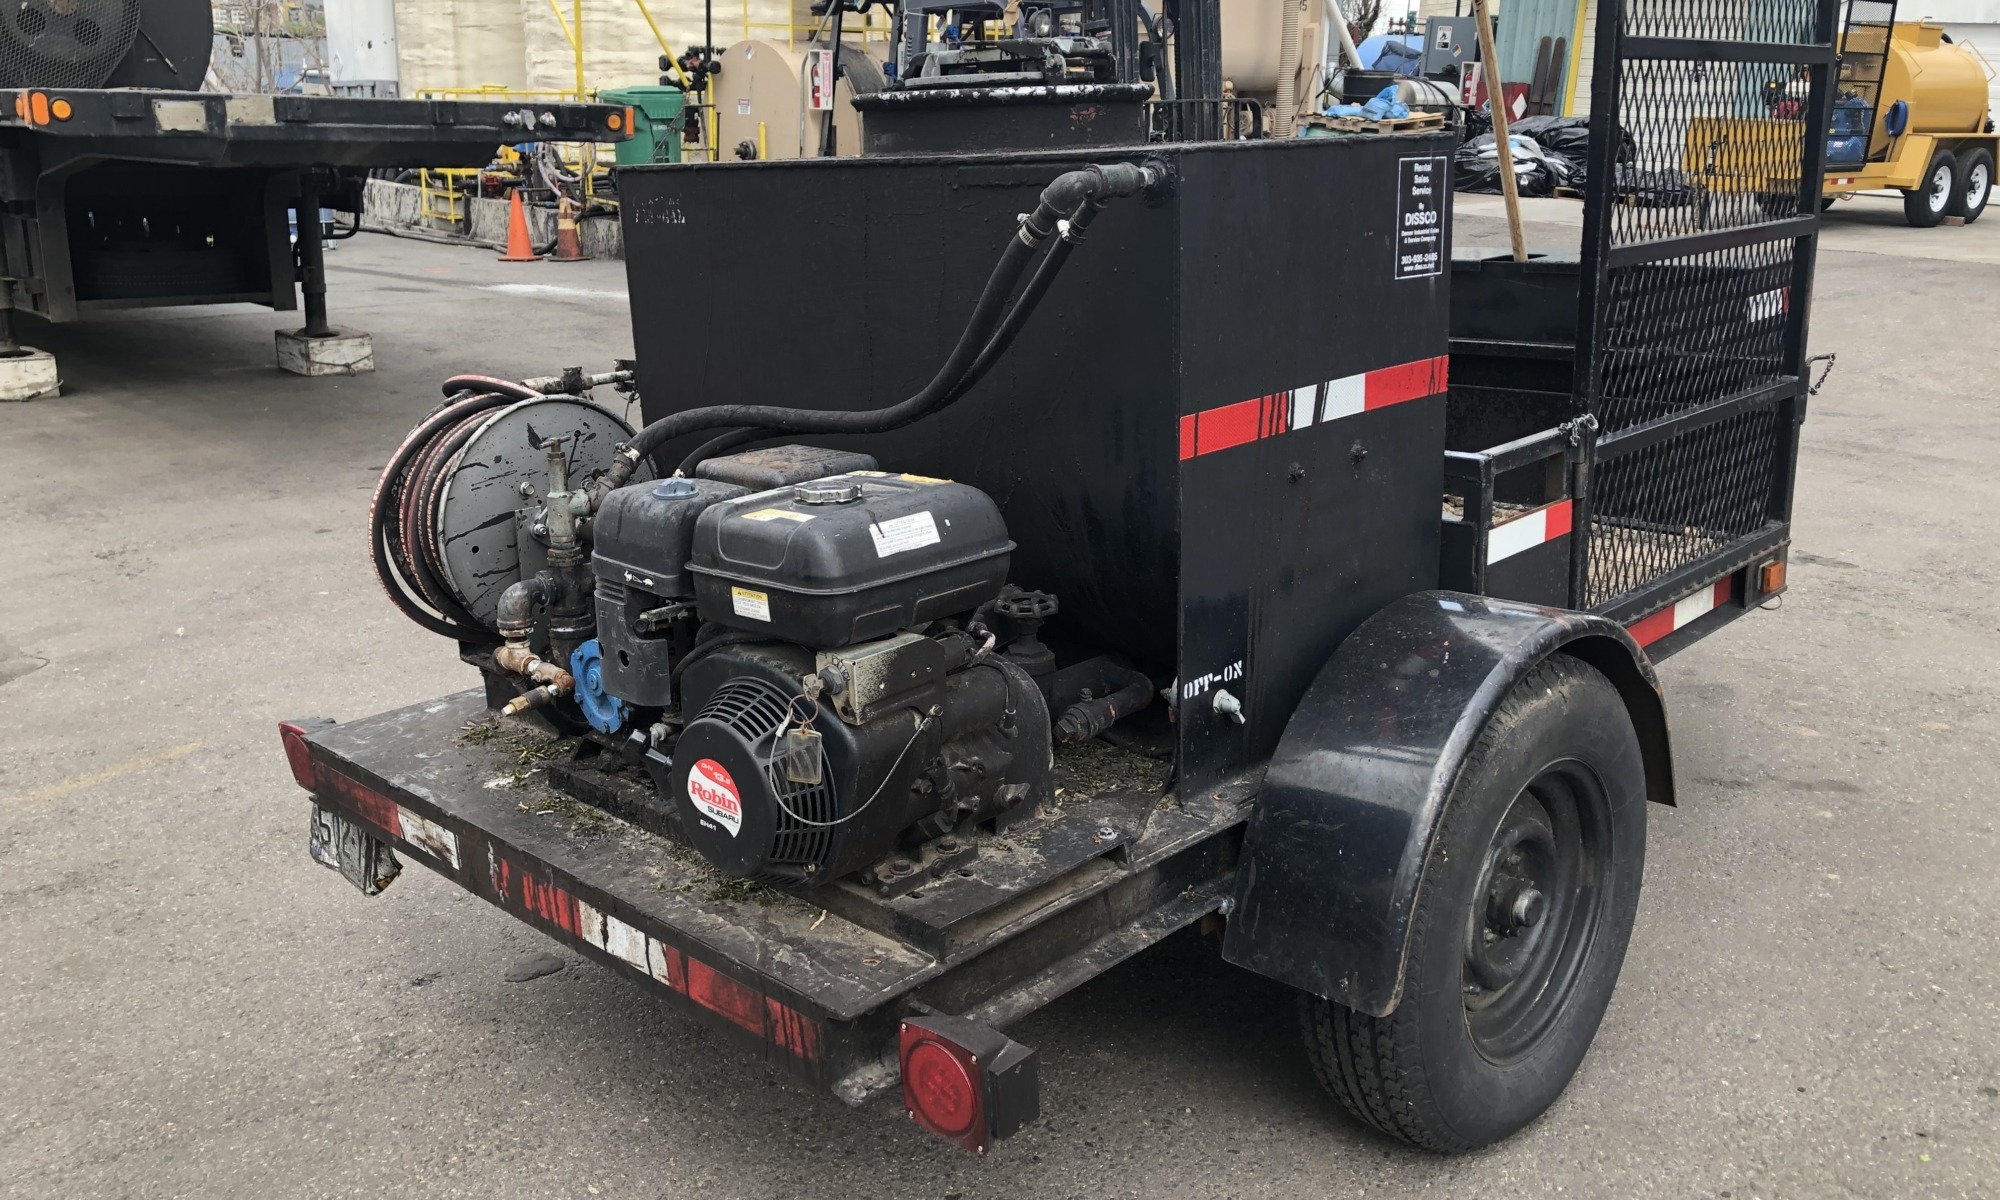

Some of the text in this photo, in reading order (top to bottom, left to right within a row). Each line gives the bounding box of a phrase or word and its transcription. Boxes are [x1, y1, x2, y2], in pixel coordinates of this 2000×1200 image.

[1414, 163, 1432, 172] Rental
[1414, 174, 1430, 184] Sales
[1412, 186, 1432, 196] Service
[1405, 211, 1437, 226] DISSCO
[713, 771, 731, 785] 13.5
[690, 780, 738, 812] Robin
[707, 805, 739, 824] SUBARU
[700, 819, 717, 831] EH41
